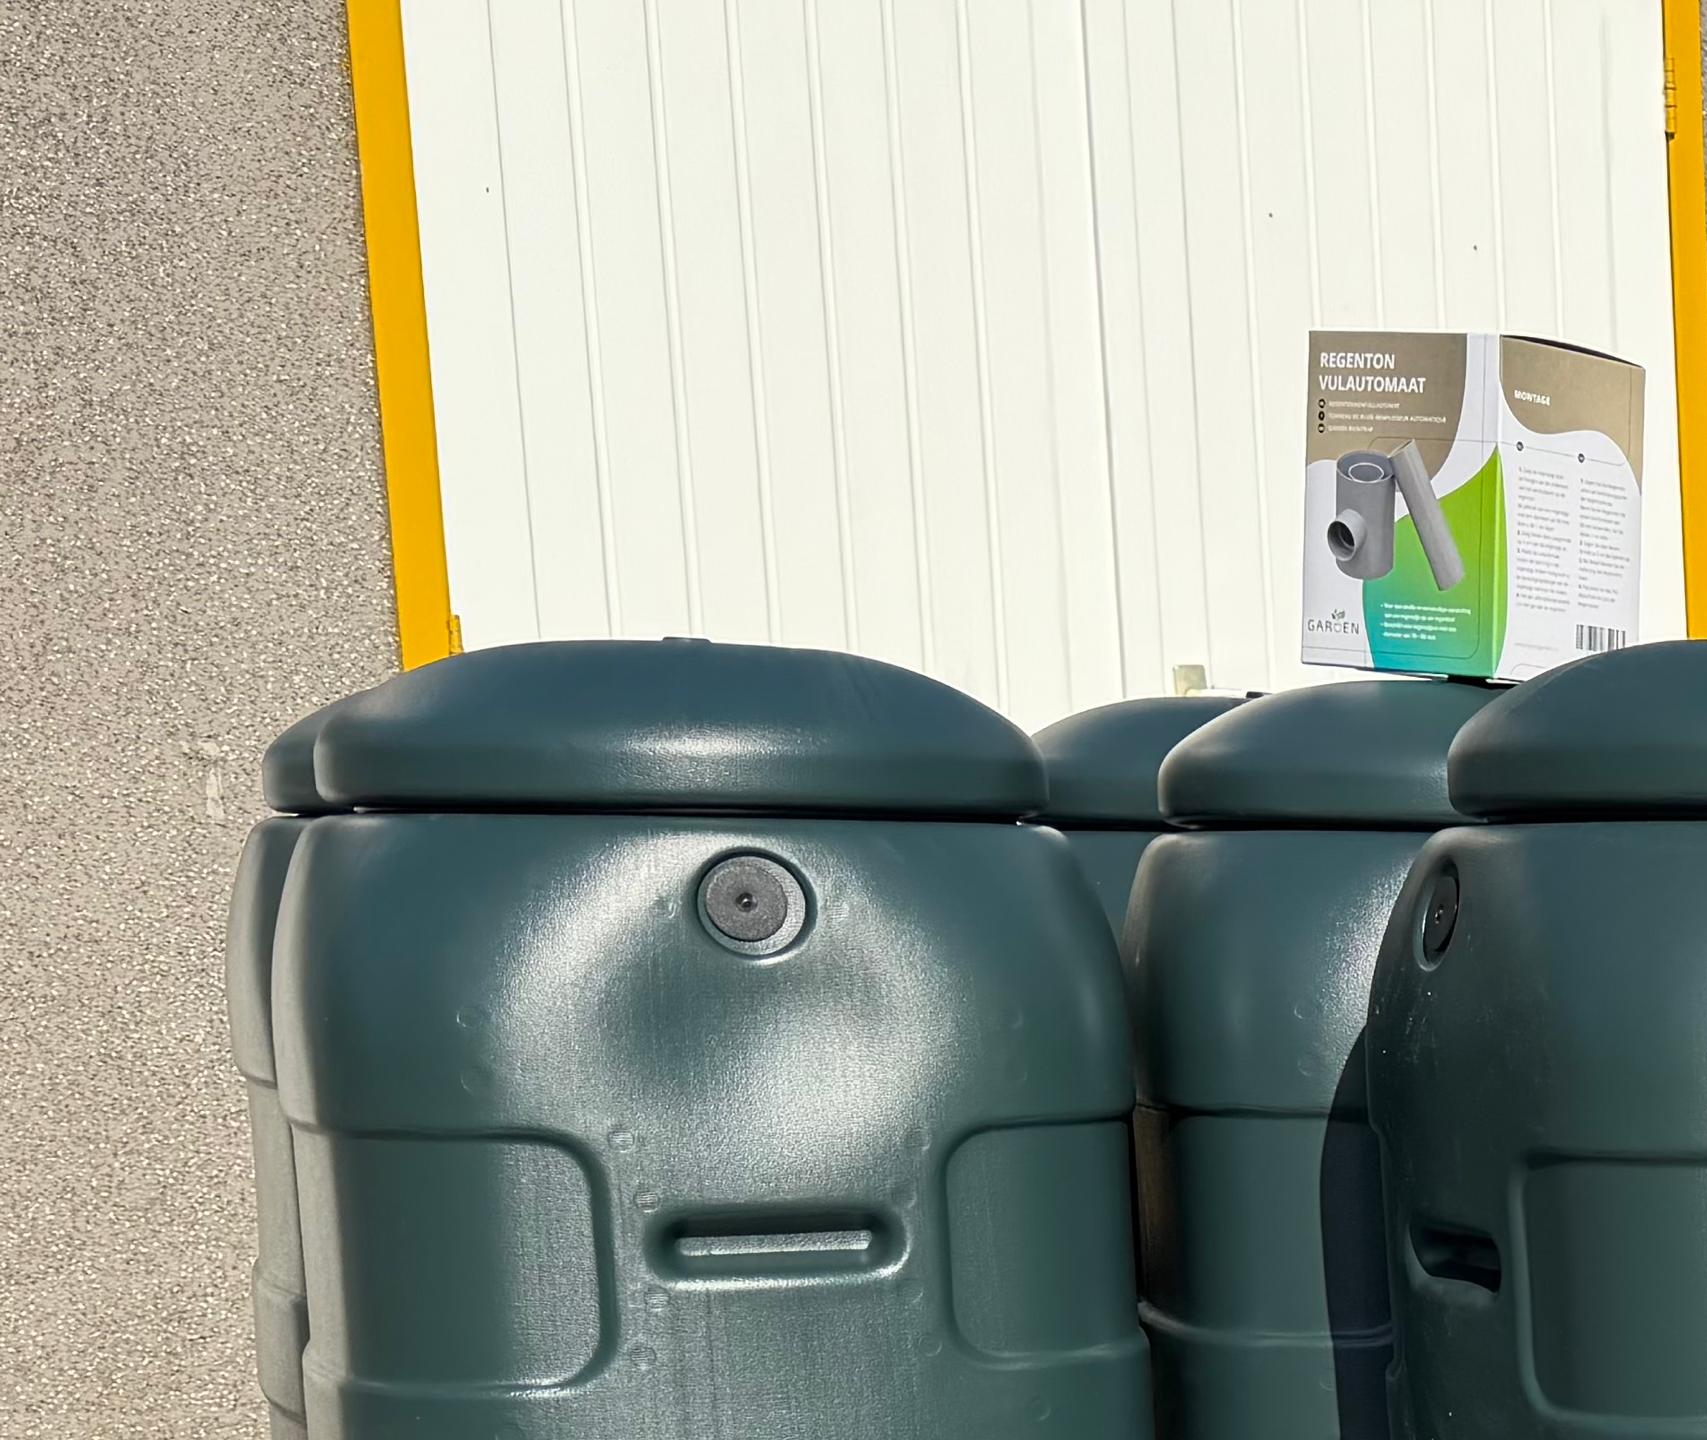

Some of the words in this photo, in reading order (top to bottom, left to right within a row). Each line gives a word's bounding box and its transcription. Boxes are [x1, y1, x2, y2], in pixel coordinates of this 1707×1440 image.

[1320, 352, 1395, 369] REGENTON
[1319, 375, 1426, 393] VULAUTOMAAT
[1514, 389, 1551, 406] MONTAGE
